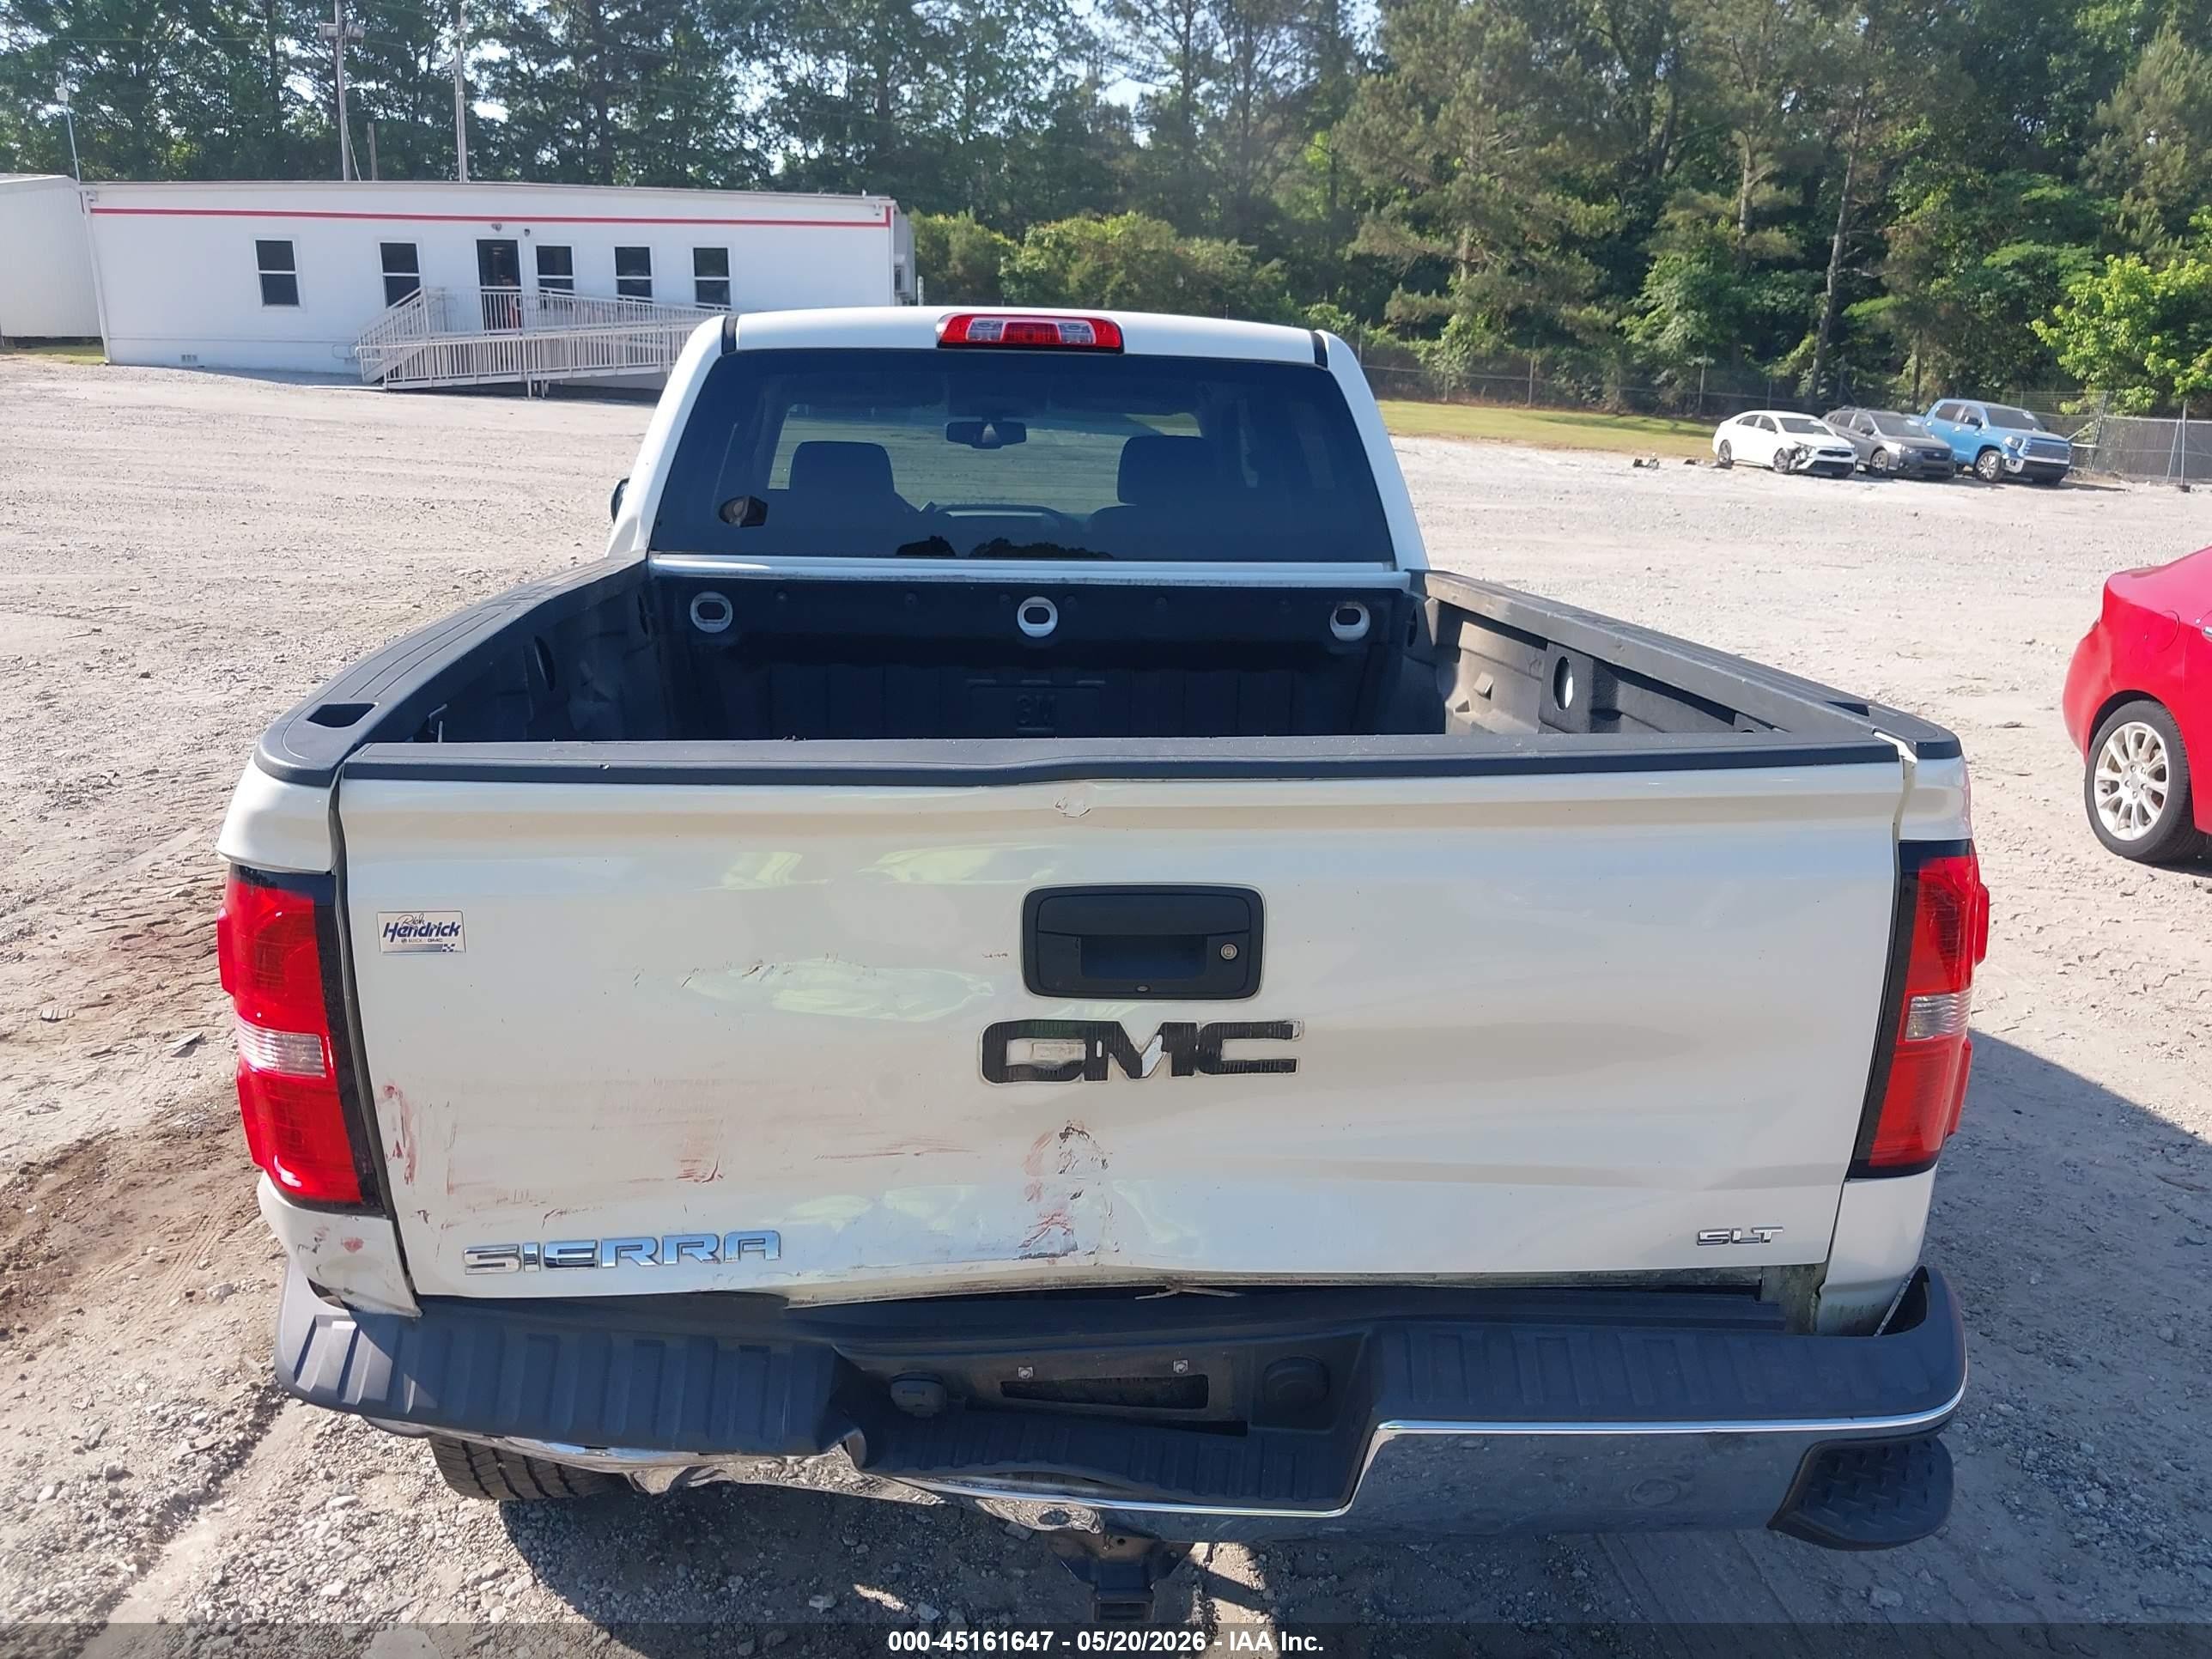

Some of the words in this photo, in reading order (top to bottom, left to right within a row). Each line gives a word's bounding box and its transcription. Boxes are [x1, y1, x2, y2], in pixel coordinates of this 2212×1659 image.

[398, 913, 426, 927] Rick
[382, 921, 462, 943] Hendrick
[981, 1019, 1302, 1083] GMC
[1697, 1226, 1784, 1246] SLT
[464, 1230, 781, 1275] SIERRA
